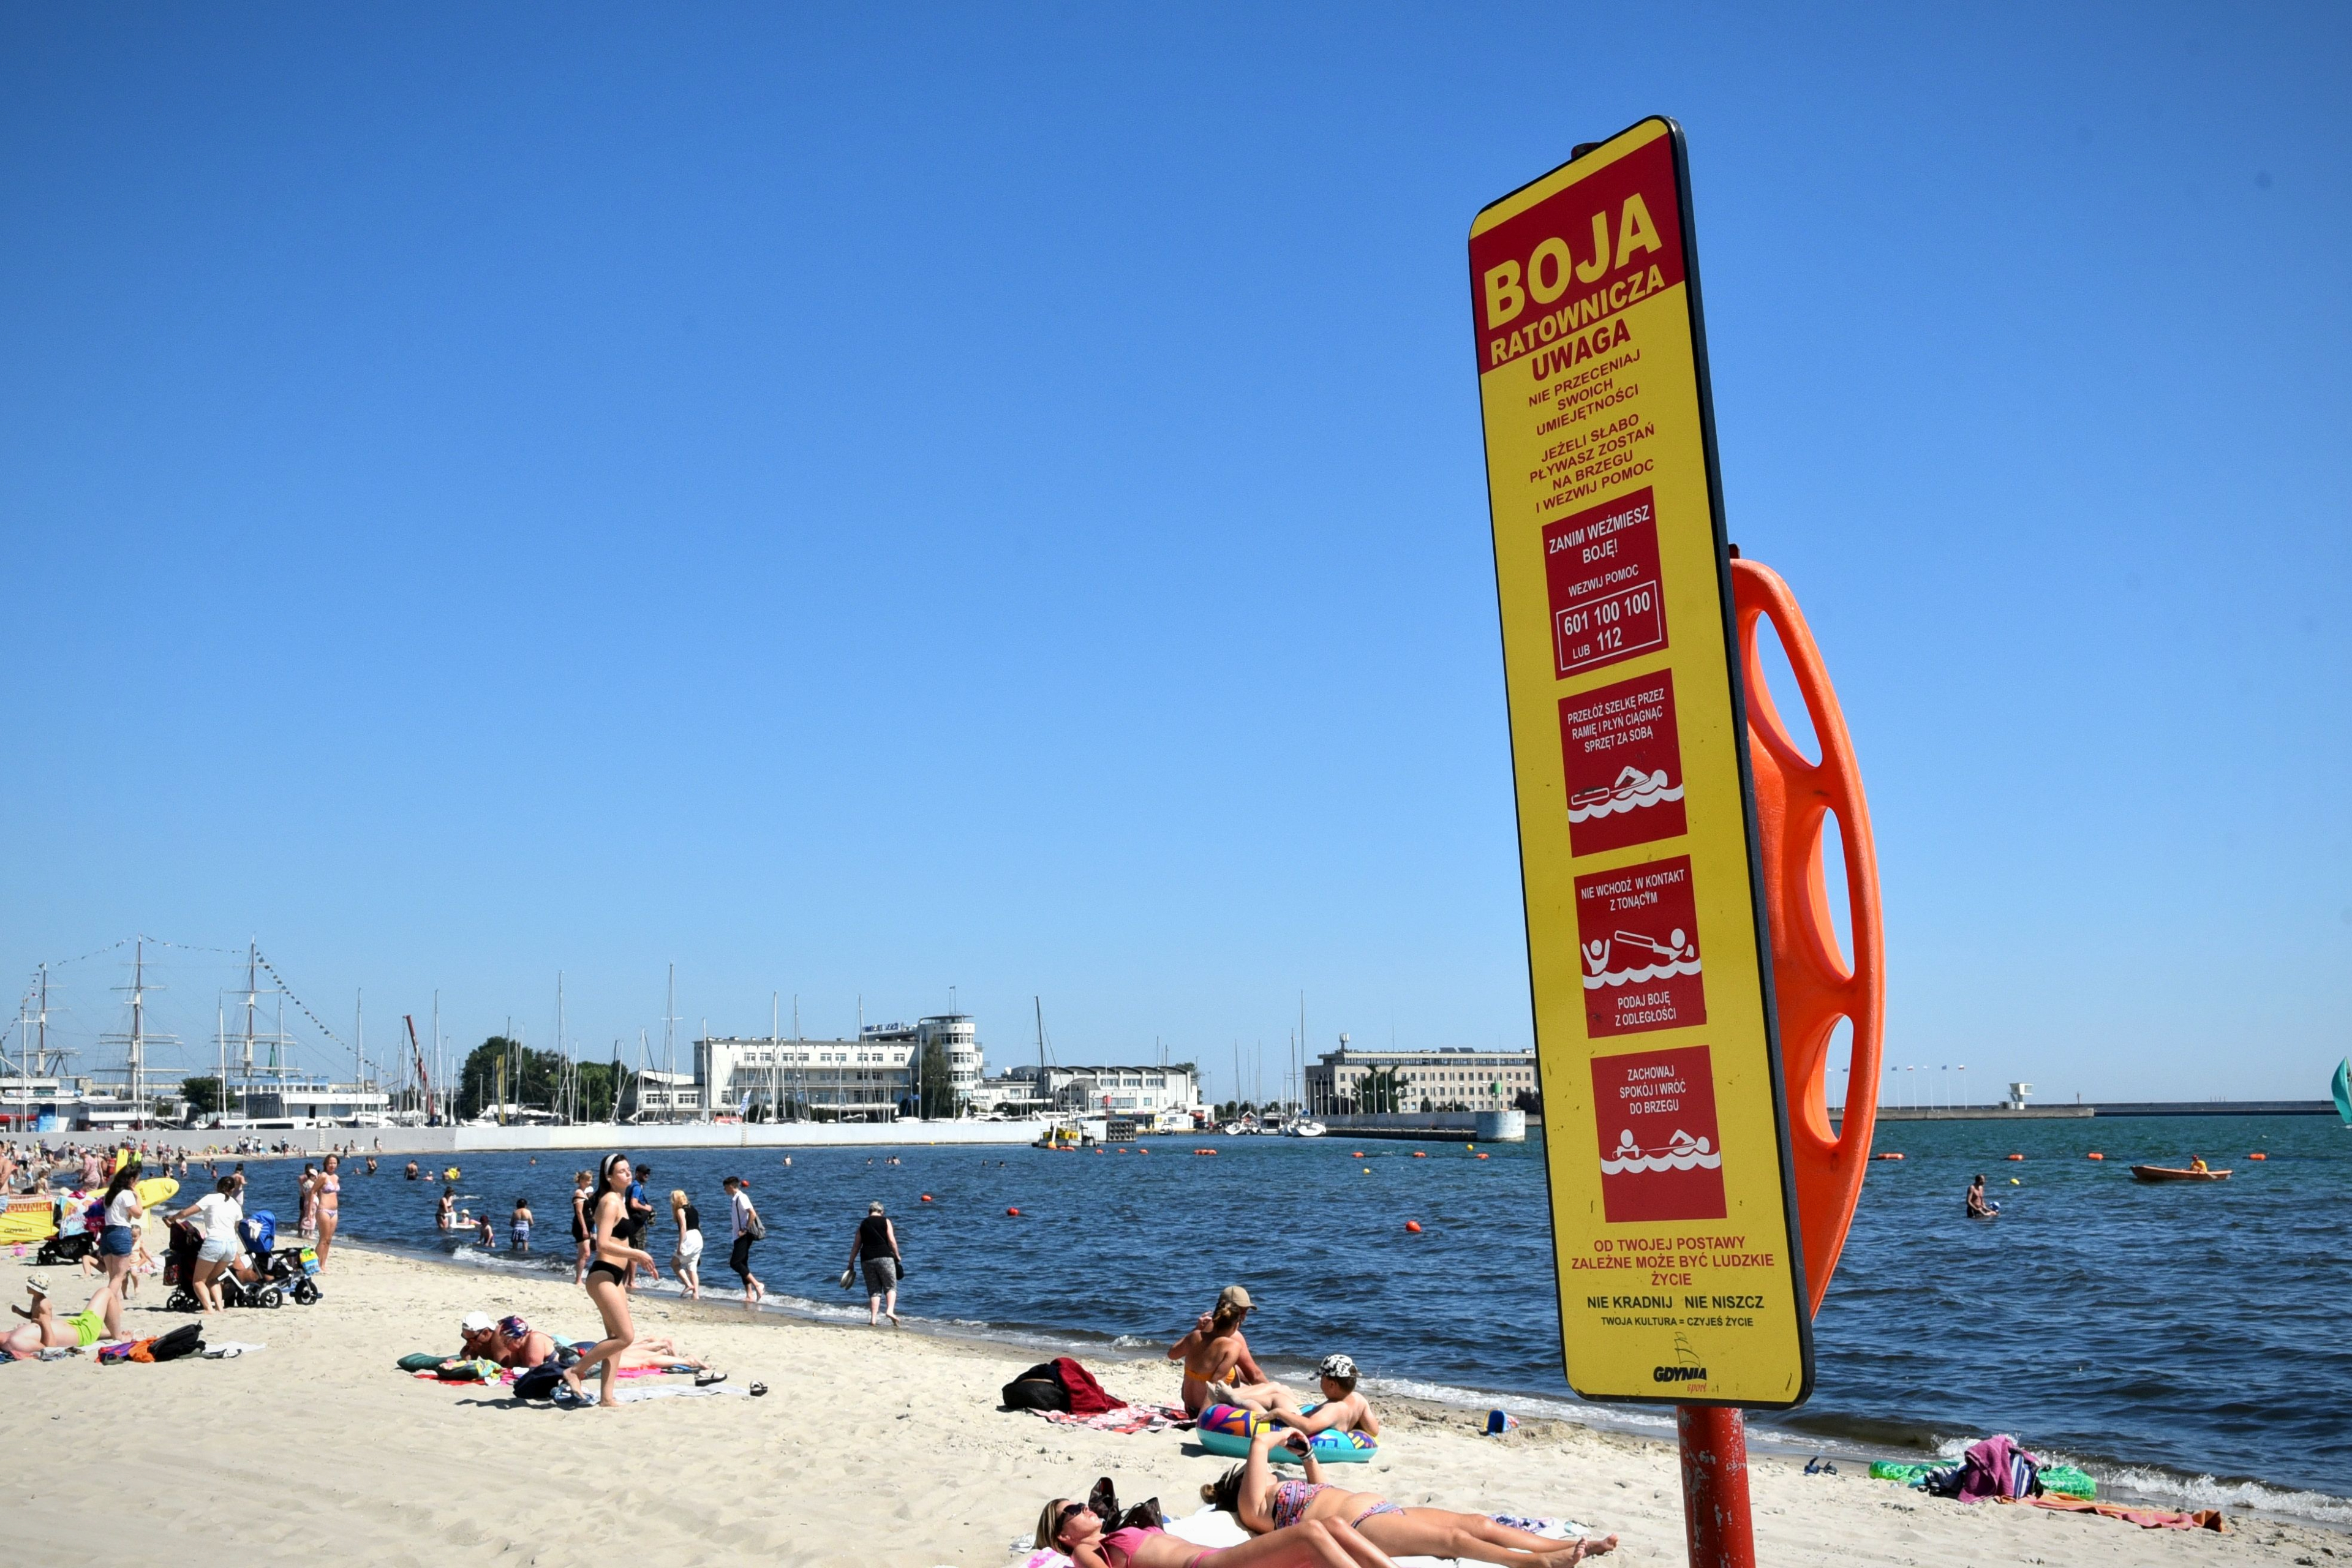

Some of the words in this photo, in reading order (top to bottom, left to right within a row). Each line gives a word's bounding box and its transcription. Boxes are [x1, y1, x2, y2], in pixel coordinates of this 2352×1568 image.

[1484, 192, 1662, 330] BOJA
[1491, 264, 1665, 366] RATOWNICZA
[1532, 318, 1630, 381] UWAGA
[1529, 389, 1550, 407] NIE
[1555, 349, 1640, 396] PRZECENIAJ
[1536, 383, 1638, 435] UMIEJĘTNOŚCI
[1558, 378, 1613, 410] SWOICH
[1530, 449, 1594, 483] PŁYWASZ
[1598, 421, 1654, 456] ZOSTAŃ
[1541, 435, 1586, 462] JEŻELI
[1591, 414, 1638, 442] SŁABO
[1536, 502, 1539, 513] I
[1544, 481, 1597, 510] WEZWIJ
[1602, 459, 1654, 488] POMOC
[1553, 475, 1572, 491] NA
[1575, 450, 1633, 481] BRZEGU
[1549, 528, 1585, 554] ZANIM
[1588, 505, 1649, 540] WEŹMIESZ
[1583, 538, 1618, 564] BOJĘ!
[1569, 576, 1603, 597] WEZWIJ
[1605, 564, 1638, 585] POMOC
[1564, 611, 1588, 635] 601
[1594, 601, 1619, 626] 100
[1625, 592, 1650, 616] 100
[1573, 644, 1590, 659] LUB
[1597, 627, 1622, 651] 112
[1568, 703, 1604, 725] PRZEŁÓŻ
[1605, 696, 1636, 714] SZELKĘ
[1638, 688, 1664, 706] PRZEZ
[1572, 723, 1597, 740] RAMIĘ
[1599, 722, 1601, 733] I
[1603, 714, 1623, 732] PŁYŃ
[1626, 706, 1663, 726] CIĄGNĄC
[1585, 735, 1615, 753] SPRZĘT
[1617, 732, 1628, 745] ZA
[1630, 726, 1653, 742] SOBĄ
[1581, 887, 1594, 899] NIE
[1596, 876, 1632, 897] WCHODŹ
[1635, 877, 1643, 889] W
[1646, 869, 1684, 888] KONTAKT
[1610, 899, 1616, 911] Z
[1617, 892, 1657, 910] TONĄCYM
[1618, 995, 1645, 1009] PODAJ
[1648, 991, 1671, 1006] BOJĘ
[1615, 1015, 1621, 1027] Z
[1623, 1006, 1676, 1025] ODLEGŁOŚCI
[1619, 1082, 1653, 1099] SPOKÓJ
[1656, 1084, 1657, 1095] I
[1659, 1078, 1686, 1094] WRÓĆ
[1627, 1065, 1675, 1081] ZACHOWAJ
[1630, 1102, 1642, 1114] DO
[1645, 1099, 1679, 1114] BRZEGU
[1594, 1240, 1613, 1253] OD
[1617, 1238, 1672, 1252] TWOJEJ
[1677, 1236, 1746, 1250] POSTAWY
[1572, 1254, 1632, 1270] ZALEŻNE
[1636, 1253, 1675, 1268] MOŻE
[1680, 1253, 1708, 1268] BYĆ
[1713, 1254, 1774, 1267] LUDZKIE
[1651, 1270, 1692, 1286] ŻYCIE
[1587, 1296, 1609, 1308] NIE
[1613, 1296, 1673, 1308] KRADNIJ
[1685, 1296, 1708, 1308] NIE
[1712, 1295, 1764, 1308] NISZCZ
[1635, 1317, 1677, 1325] KULTURA
[1687, 1316, 1723, 1326] CZYJEŚ
[1725, 1316, 1753, 1326] ŻYCIE
[1653, 1366, 1707, 1382] GDYNIA
[1687, 1382, 1706, 1394] sport
